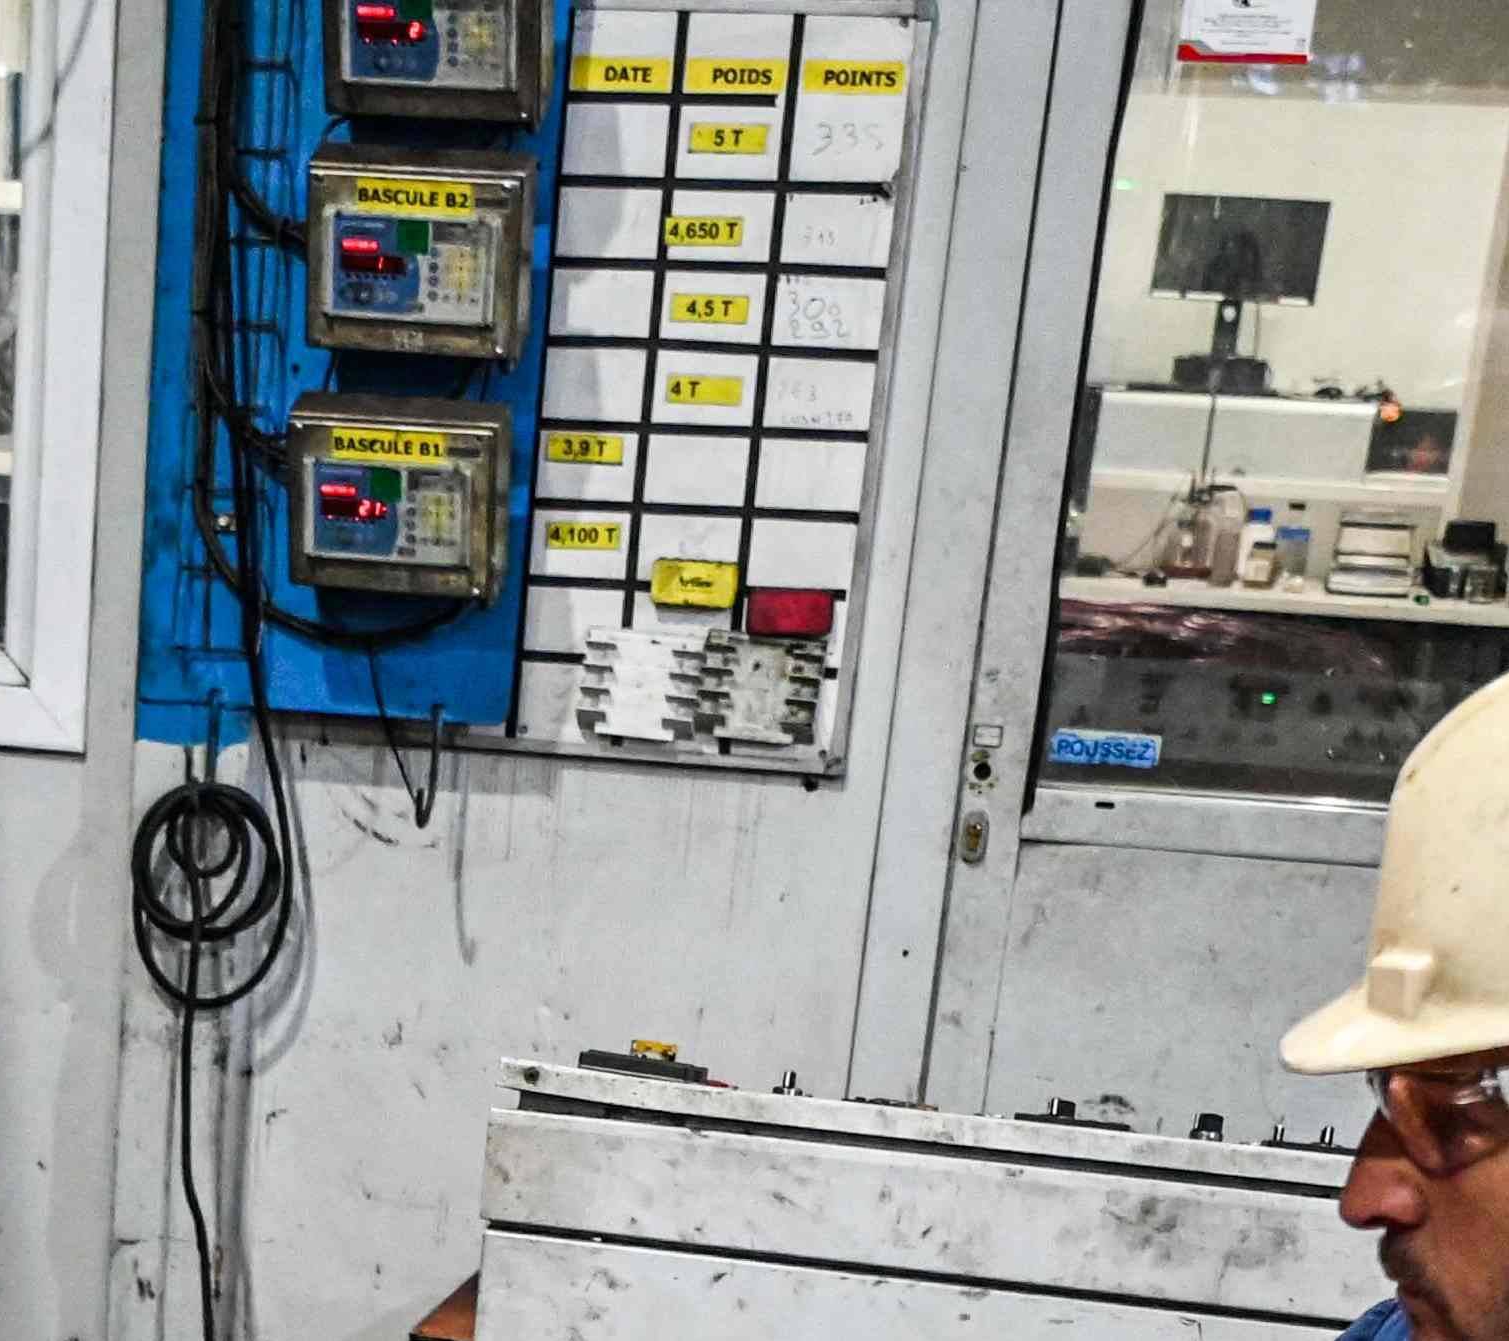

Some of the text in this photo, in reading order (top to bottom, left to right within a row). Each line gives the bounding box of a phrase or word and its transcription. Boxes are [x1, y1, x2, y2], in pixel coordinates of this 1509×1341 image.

[604, 66, 653, 83] DATE
[712, 67, 773, 85] POIDS
[823, 69, 897, 88] POINTS
[713, 129, 743, 146] 5 T
[358, 188, 470, 209] BASCULE B2
[669, 222, 738, 242] 4,650 T
[685, 300, 733, 319] 4,5 T
[670, 380, 700, 398] 4 T
[334, 436, 413, 456] BASCULE
[562, 439, 607, 458] 3,9 T
[549, 527, 617, 545] 4,100 T
[1056, 739, 1151, 761] POUSSEZ
